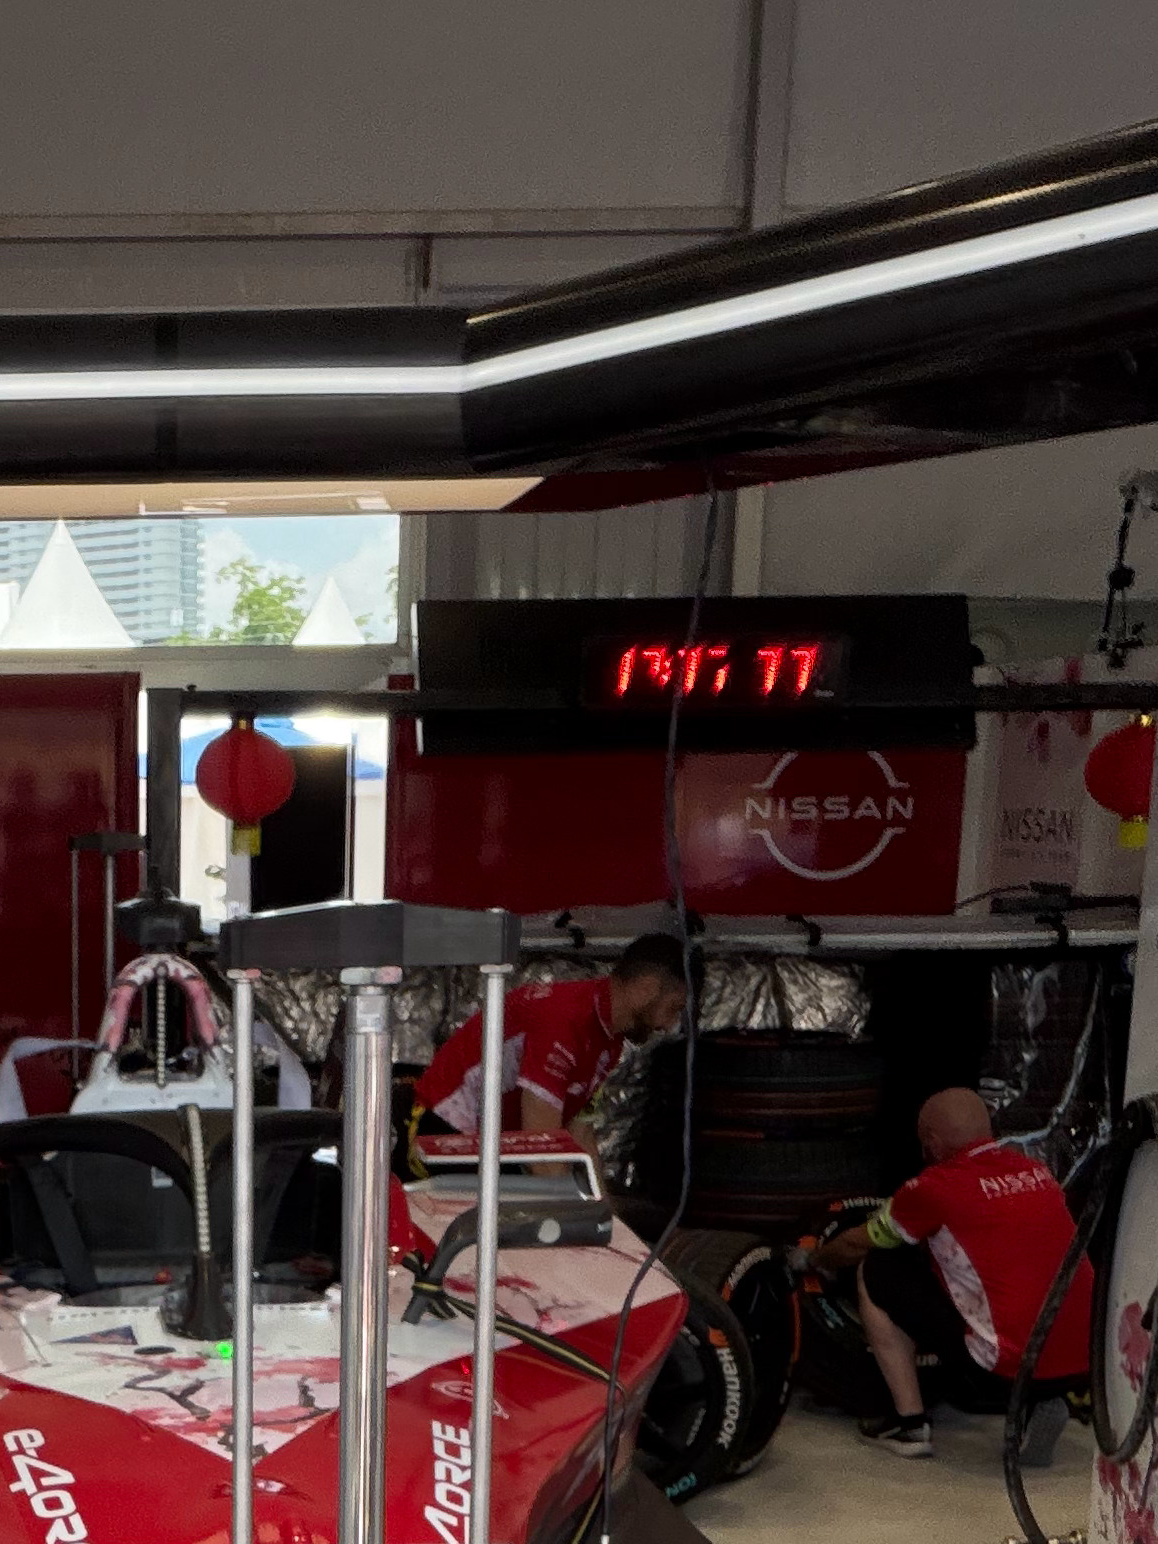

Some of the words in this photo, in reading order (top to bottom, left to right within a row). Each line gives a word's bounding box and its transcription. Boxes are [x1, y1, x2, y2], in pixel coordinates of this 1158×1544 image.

[745, 795, 915, 821] NISSAN
[1000, 806, 1075, 843] NISSAN
[715, 1347, 742, 1450] Hankook
